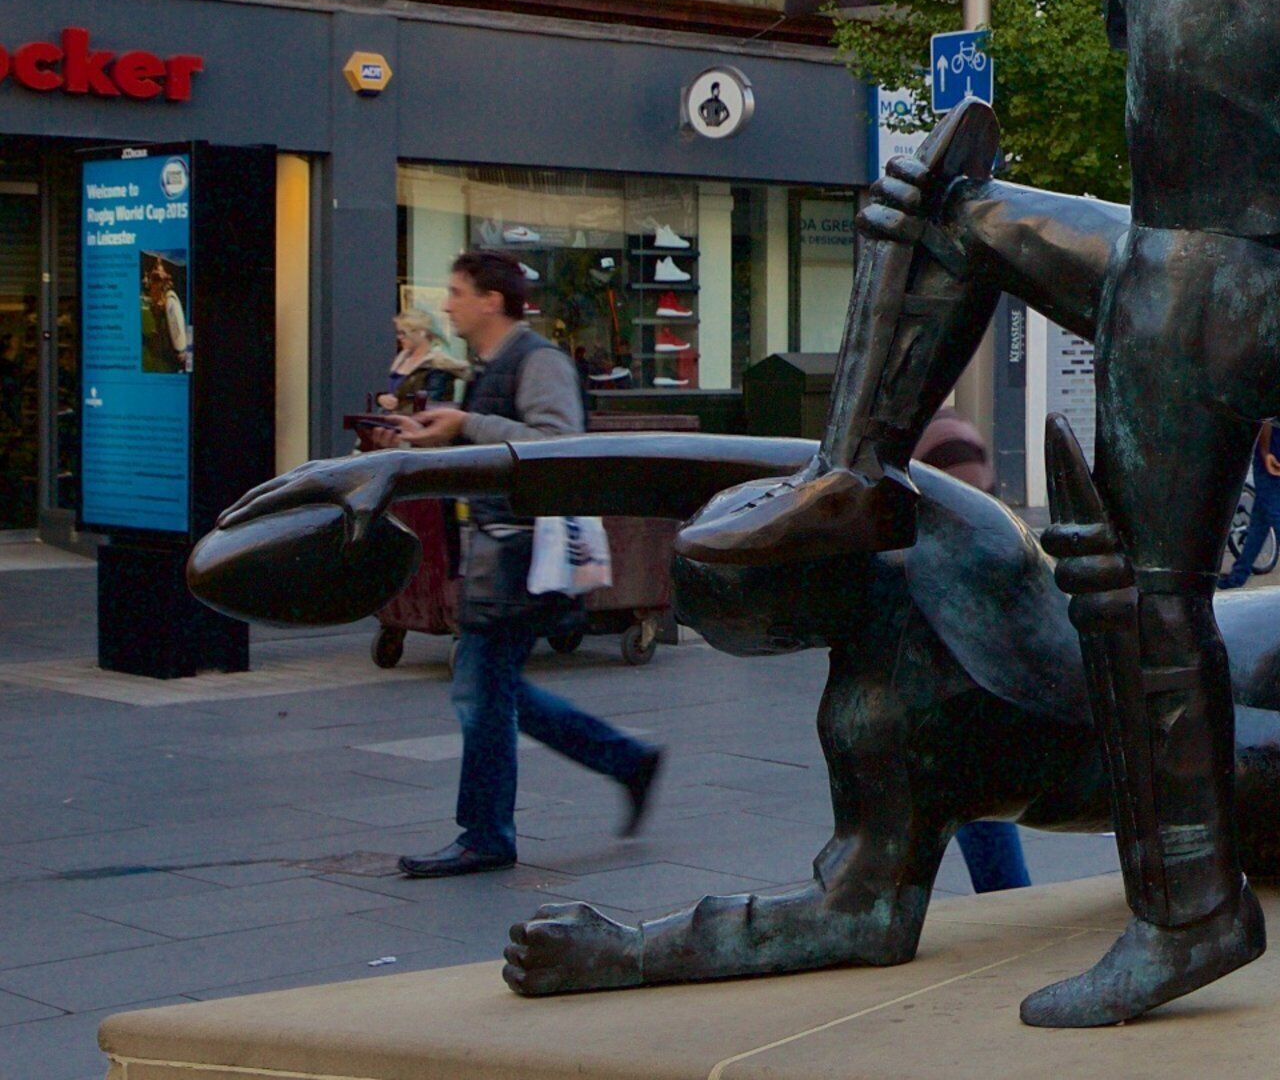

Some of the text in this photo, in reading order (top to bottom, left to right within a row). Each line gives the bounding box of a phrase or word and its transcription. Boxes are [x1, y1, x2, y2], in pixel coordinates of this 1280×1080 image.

[0, 26, 204, 102] cker
[86, 182, 139, 199] Welcome to
[87, 202, 188, 226] Rugby World Cup 2015
[87, 230, 136, 246] in Leicester
